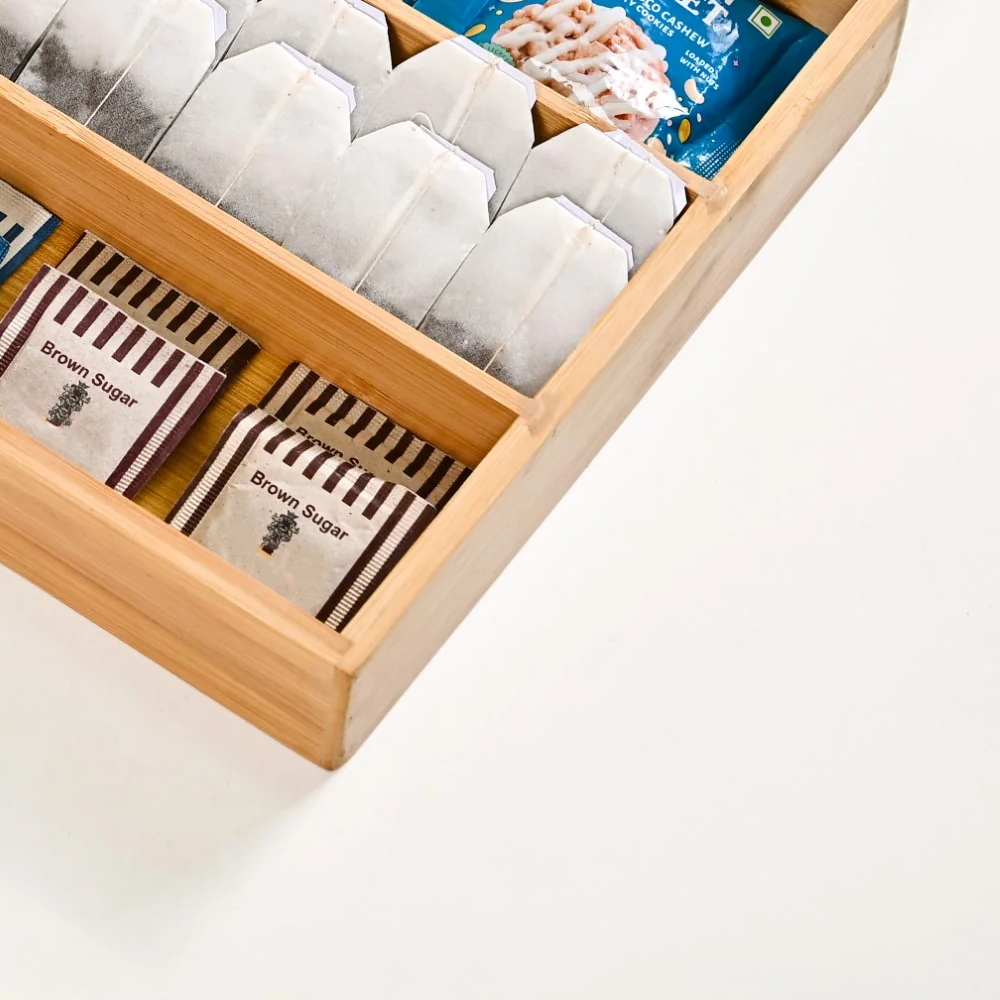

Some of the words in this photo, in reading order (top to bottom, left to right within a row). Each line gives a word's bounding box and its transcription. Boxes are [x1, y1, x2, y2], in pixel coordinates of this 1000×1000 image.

[635, 4, 675, 38] COOKIES
[660, 10, 711, 49] CASHEW
[679, 56, 701, 76] WITH
[684, 49, 716, 75] LOADED
[40, 340, 90, 378] Brown
[91, 373, 138, 408] Sugar
[250, 470, 300, 509] Brown
[302, 504, 349, 540] Sugar
